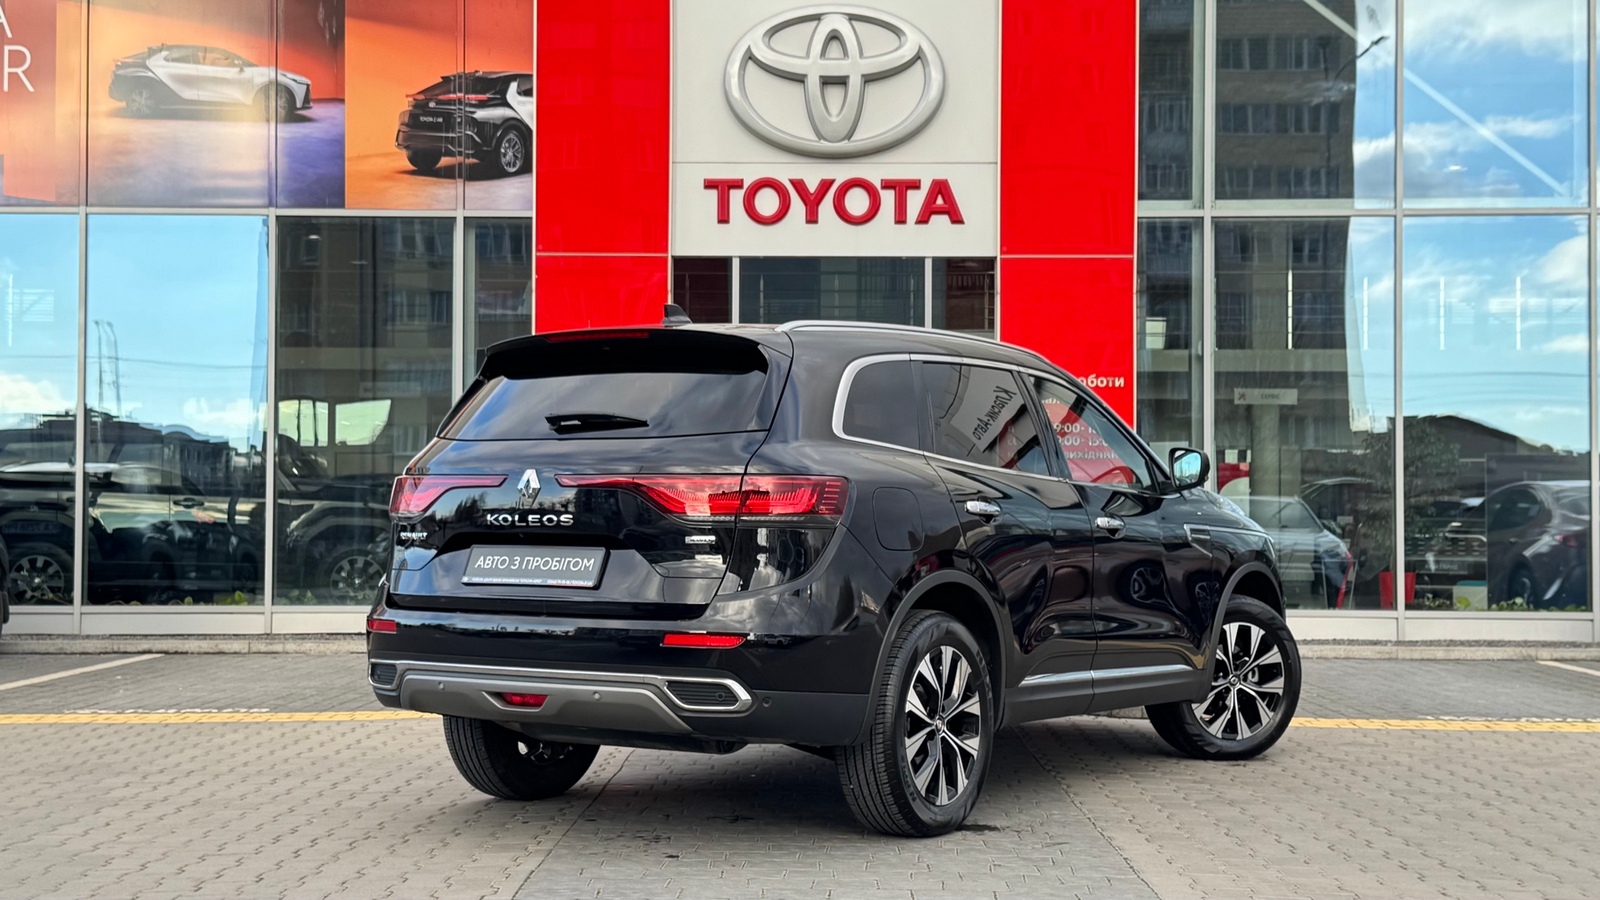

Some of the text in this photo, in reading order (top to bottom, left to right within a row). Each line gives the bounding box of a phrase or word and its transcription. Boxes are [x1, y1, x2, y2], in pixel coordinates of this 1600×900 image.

[703, 177, 966, 225] TOYOTA
[1078, 373, 1125, 388] оботи
[486, 513, 574, 526] KOLEOS
[474, 556, 509, 570] АВТО
[522, 556, 595, 572] ПРОБІГОМ
